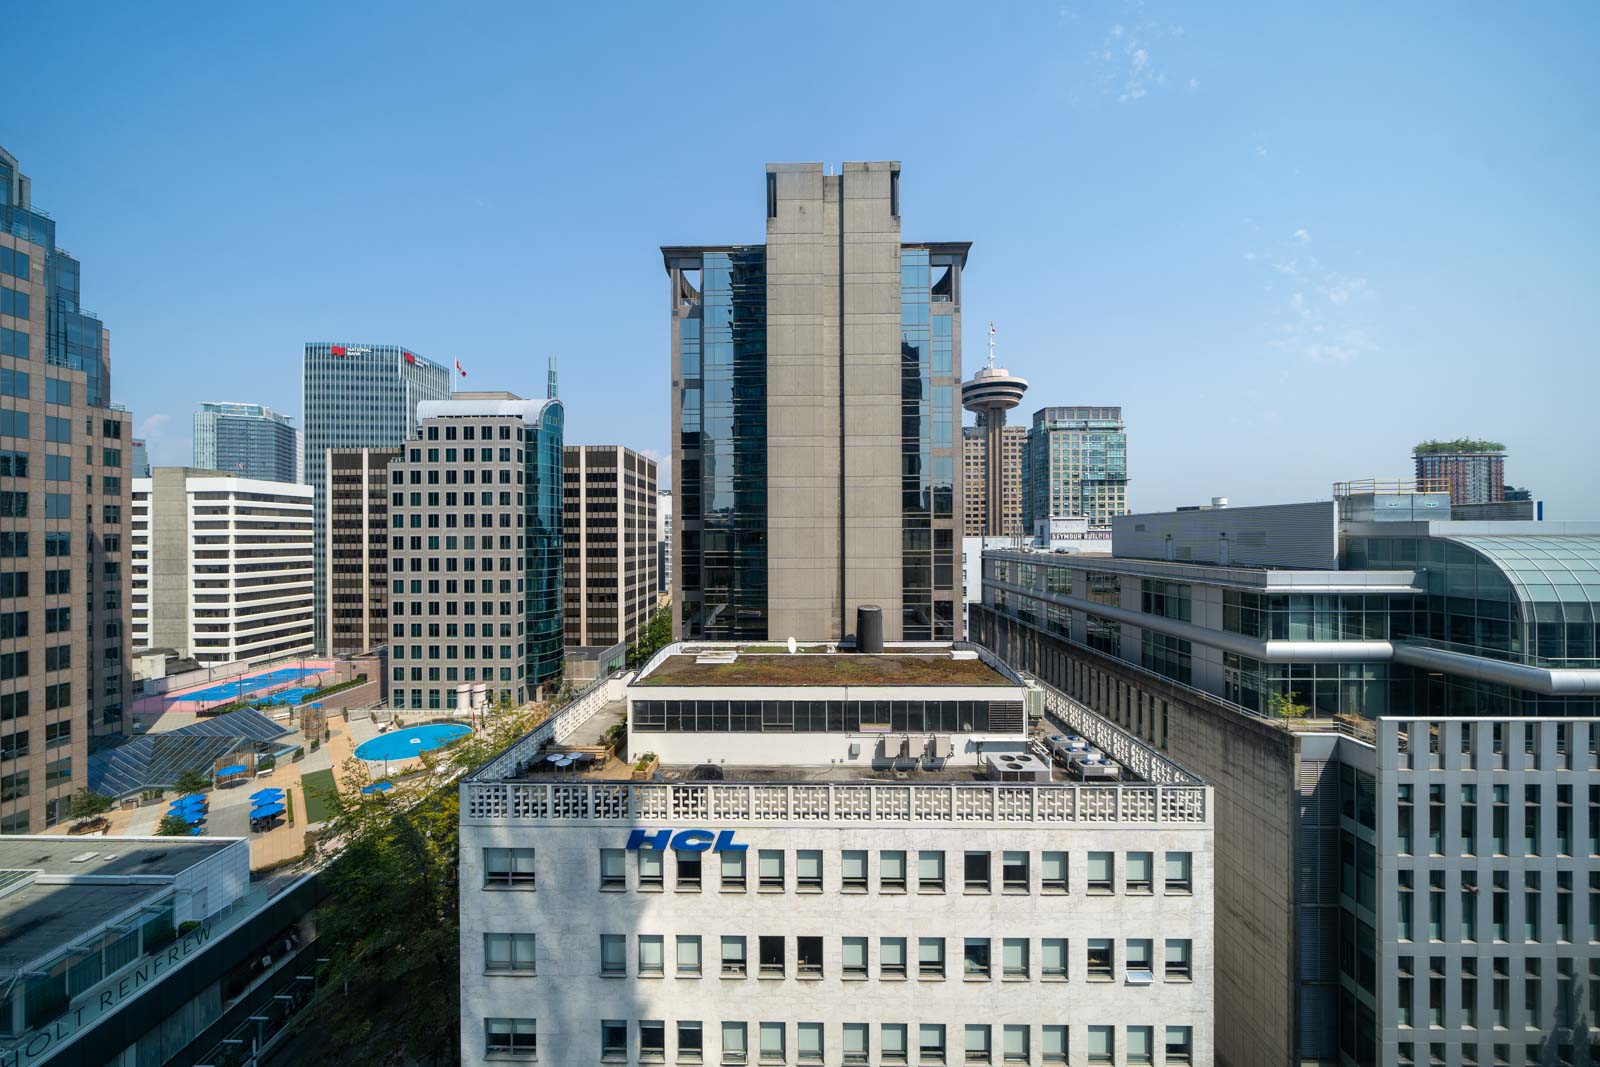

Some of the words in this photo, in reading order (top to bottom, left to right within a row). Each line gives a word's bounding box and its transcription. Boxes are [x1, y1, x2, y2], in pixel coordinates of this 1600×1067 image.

[626, 829, 749, 854] HCL
[1, 1006, 85, 1067] HOLT
[100, 924, 212, 1011] RENFREW
